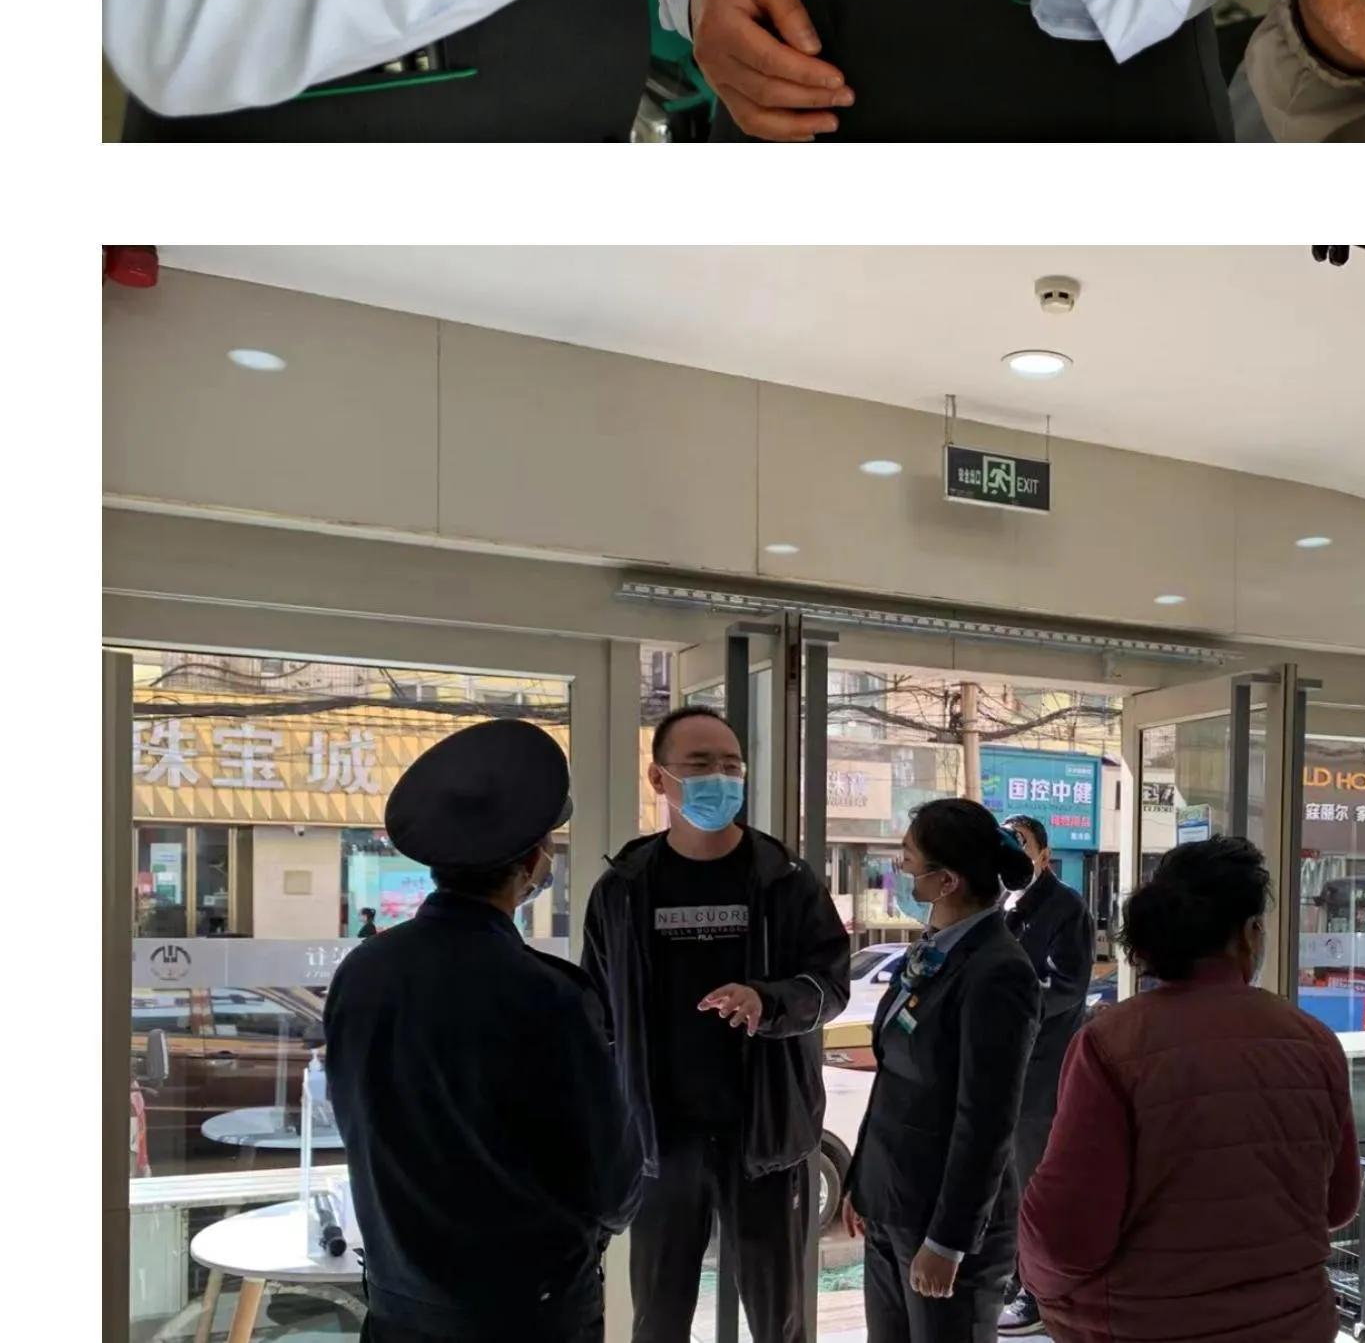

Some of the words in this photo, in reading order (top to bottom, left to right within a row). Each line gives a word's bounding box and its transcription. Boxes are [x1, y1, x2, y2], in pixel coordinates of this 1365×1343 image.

[1017, 476, 1040, 495] EXIT
[1008, 777, 1093, 804] 国控中健
[658, 912, 688, 923] NEL
